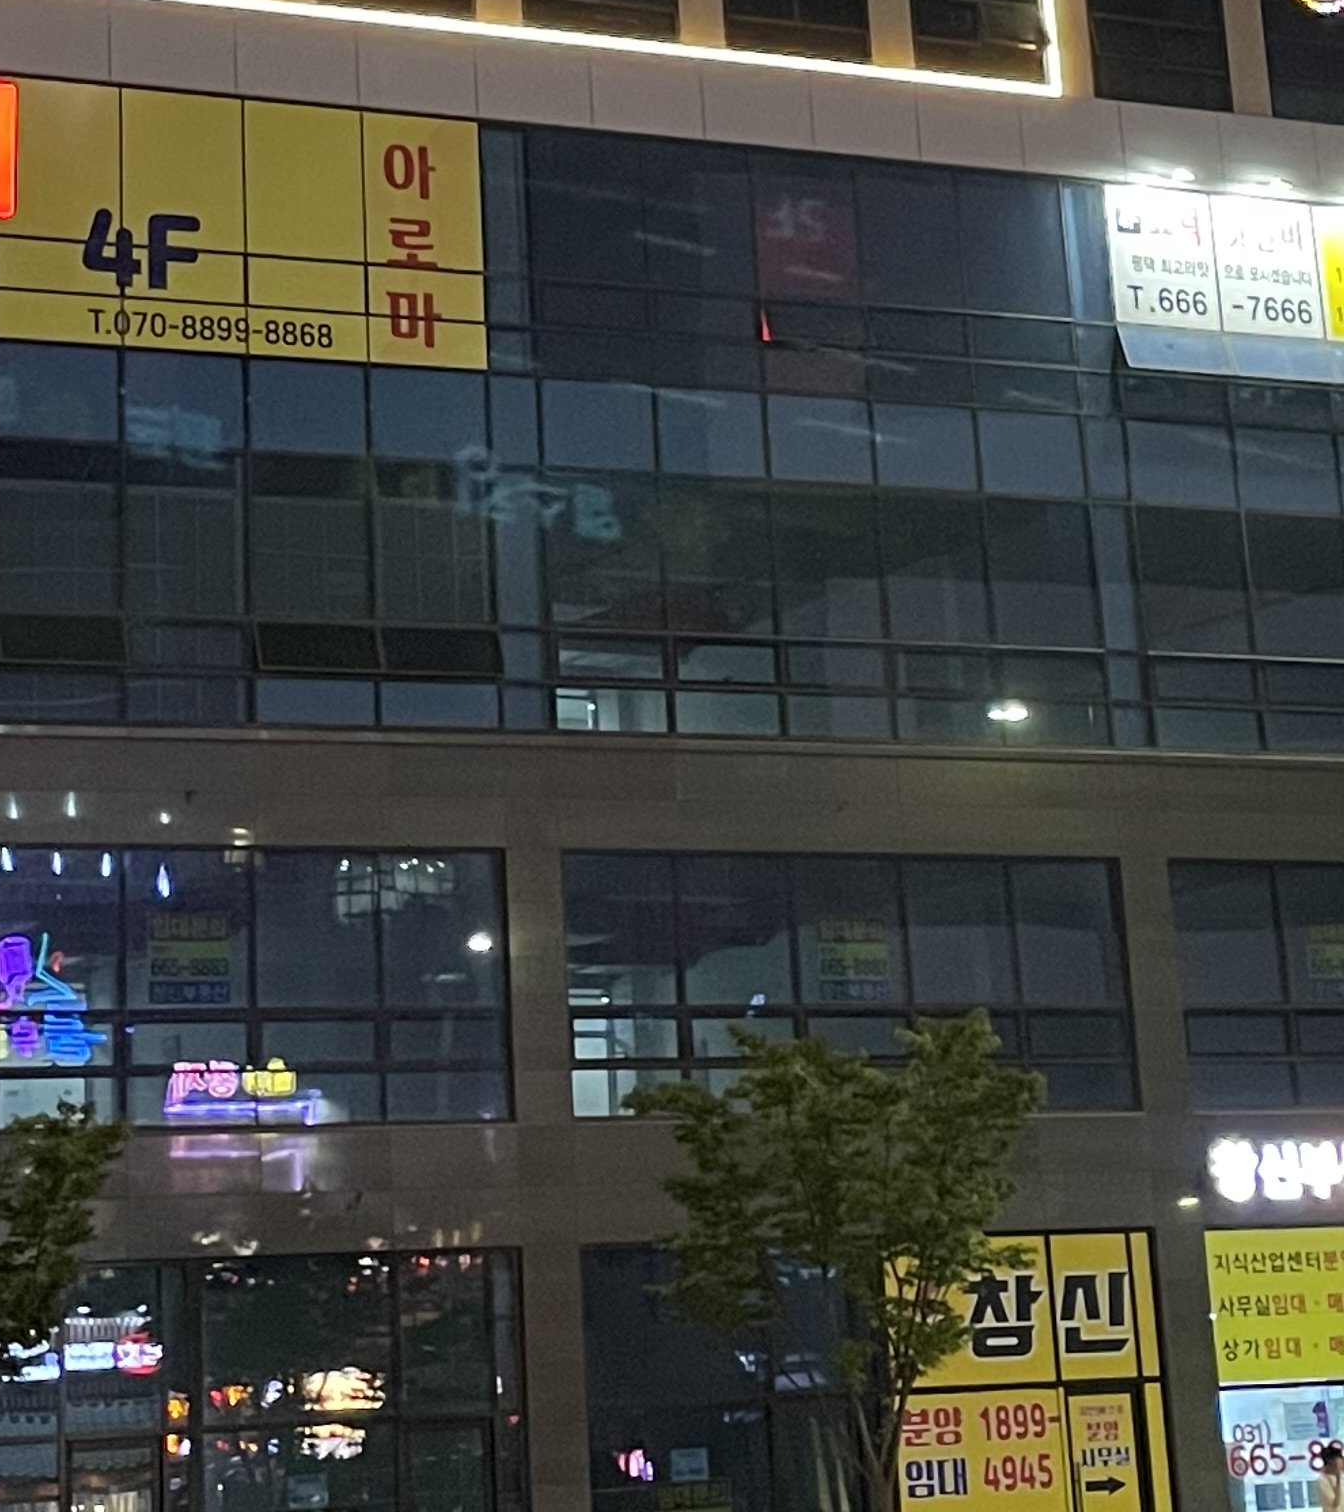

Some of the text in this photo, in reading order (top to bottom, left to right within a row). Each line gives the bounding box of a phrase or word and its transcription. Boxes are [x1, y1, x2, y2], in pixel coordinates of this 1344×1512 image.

[84, 210, 201, 289] 4F
[383, 142, 442, 350] 아로마
[88, 308, 334, 350] T.070-8899-8868
[902, 1406, 962, 1448] 분양
[1087, 1420, 1119, 1442] 분양
[1233, 1419, 1271, 1444] 031)
[905, 1453, 1054, 1499] 임대 4945
[1081, 1446, 1131, 1467] 사무실
